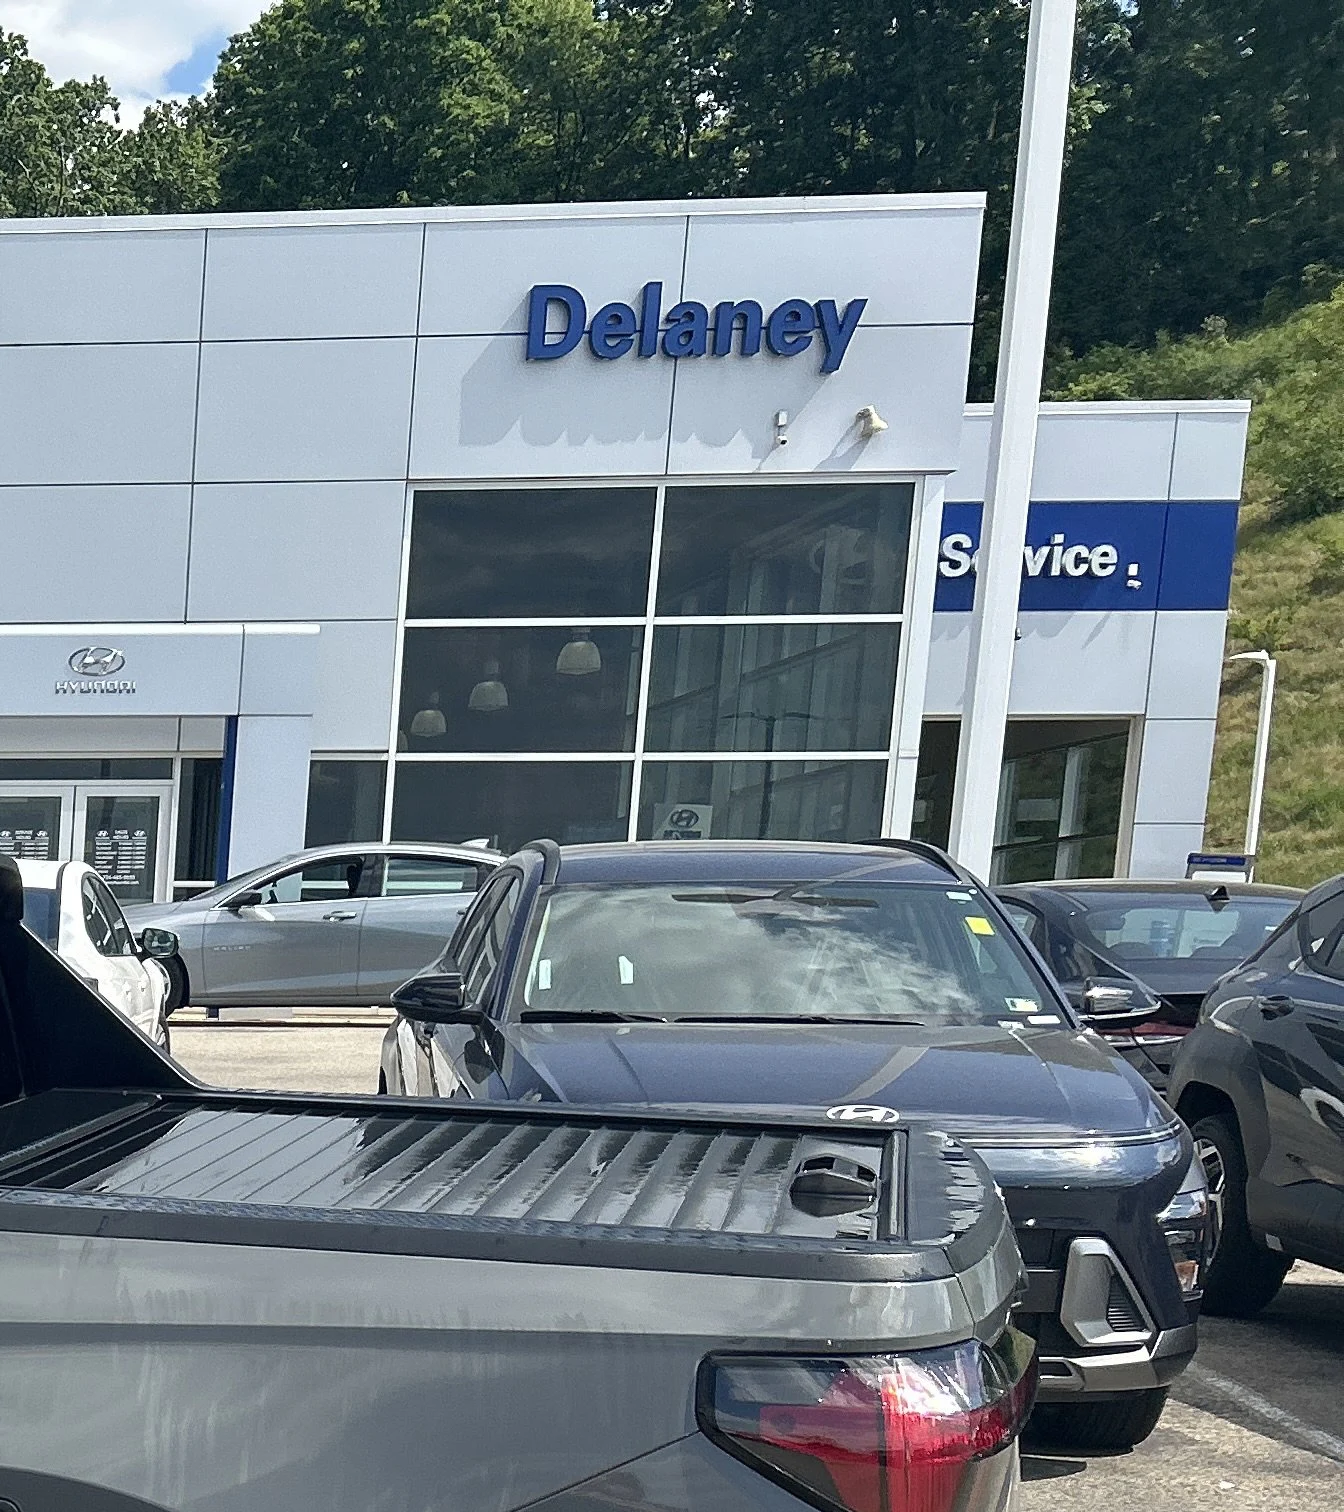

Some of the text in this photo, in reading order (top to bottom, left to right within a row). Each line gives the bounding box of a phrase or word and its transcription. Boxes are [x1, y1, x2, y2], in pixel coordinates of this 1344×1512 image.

[526, 281, 869, 374] Delaney
[939, 533, 1119, 578] Svice
[55, 680, 137, 694] HYUNDAI
